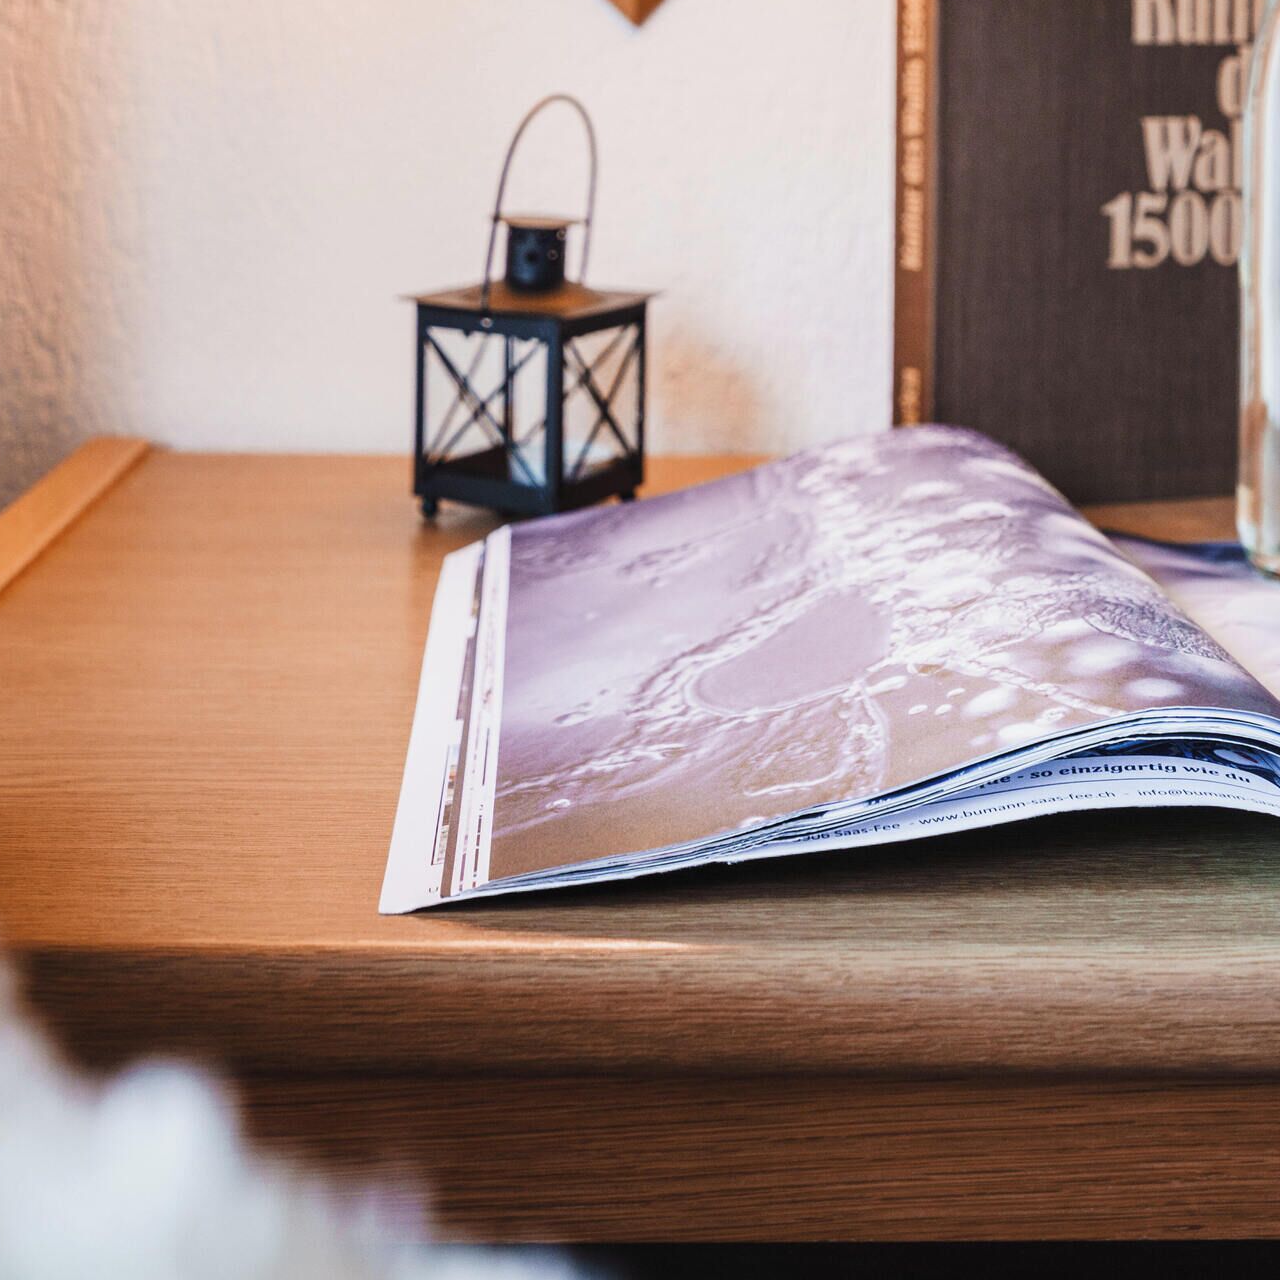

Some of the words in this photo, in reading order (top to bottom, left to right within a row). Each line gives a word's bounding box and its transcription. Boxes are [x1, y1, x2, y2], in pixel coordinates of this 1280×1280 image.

[1141, 115, 1244, 191] Wal
[1030, 769, 1053, 780] so
[1059, 762, 1177, 776] einzigartig
[1183, 765, 1220, 776] wie
[1225, 771, 1251, 784] du
[834, 823, 900, 838] Saas-Fee
[920, 790, 1116, 825] www.bumann-saas-fee.ch
